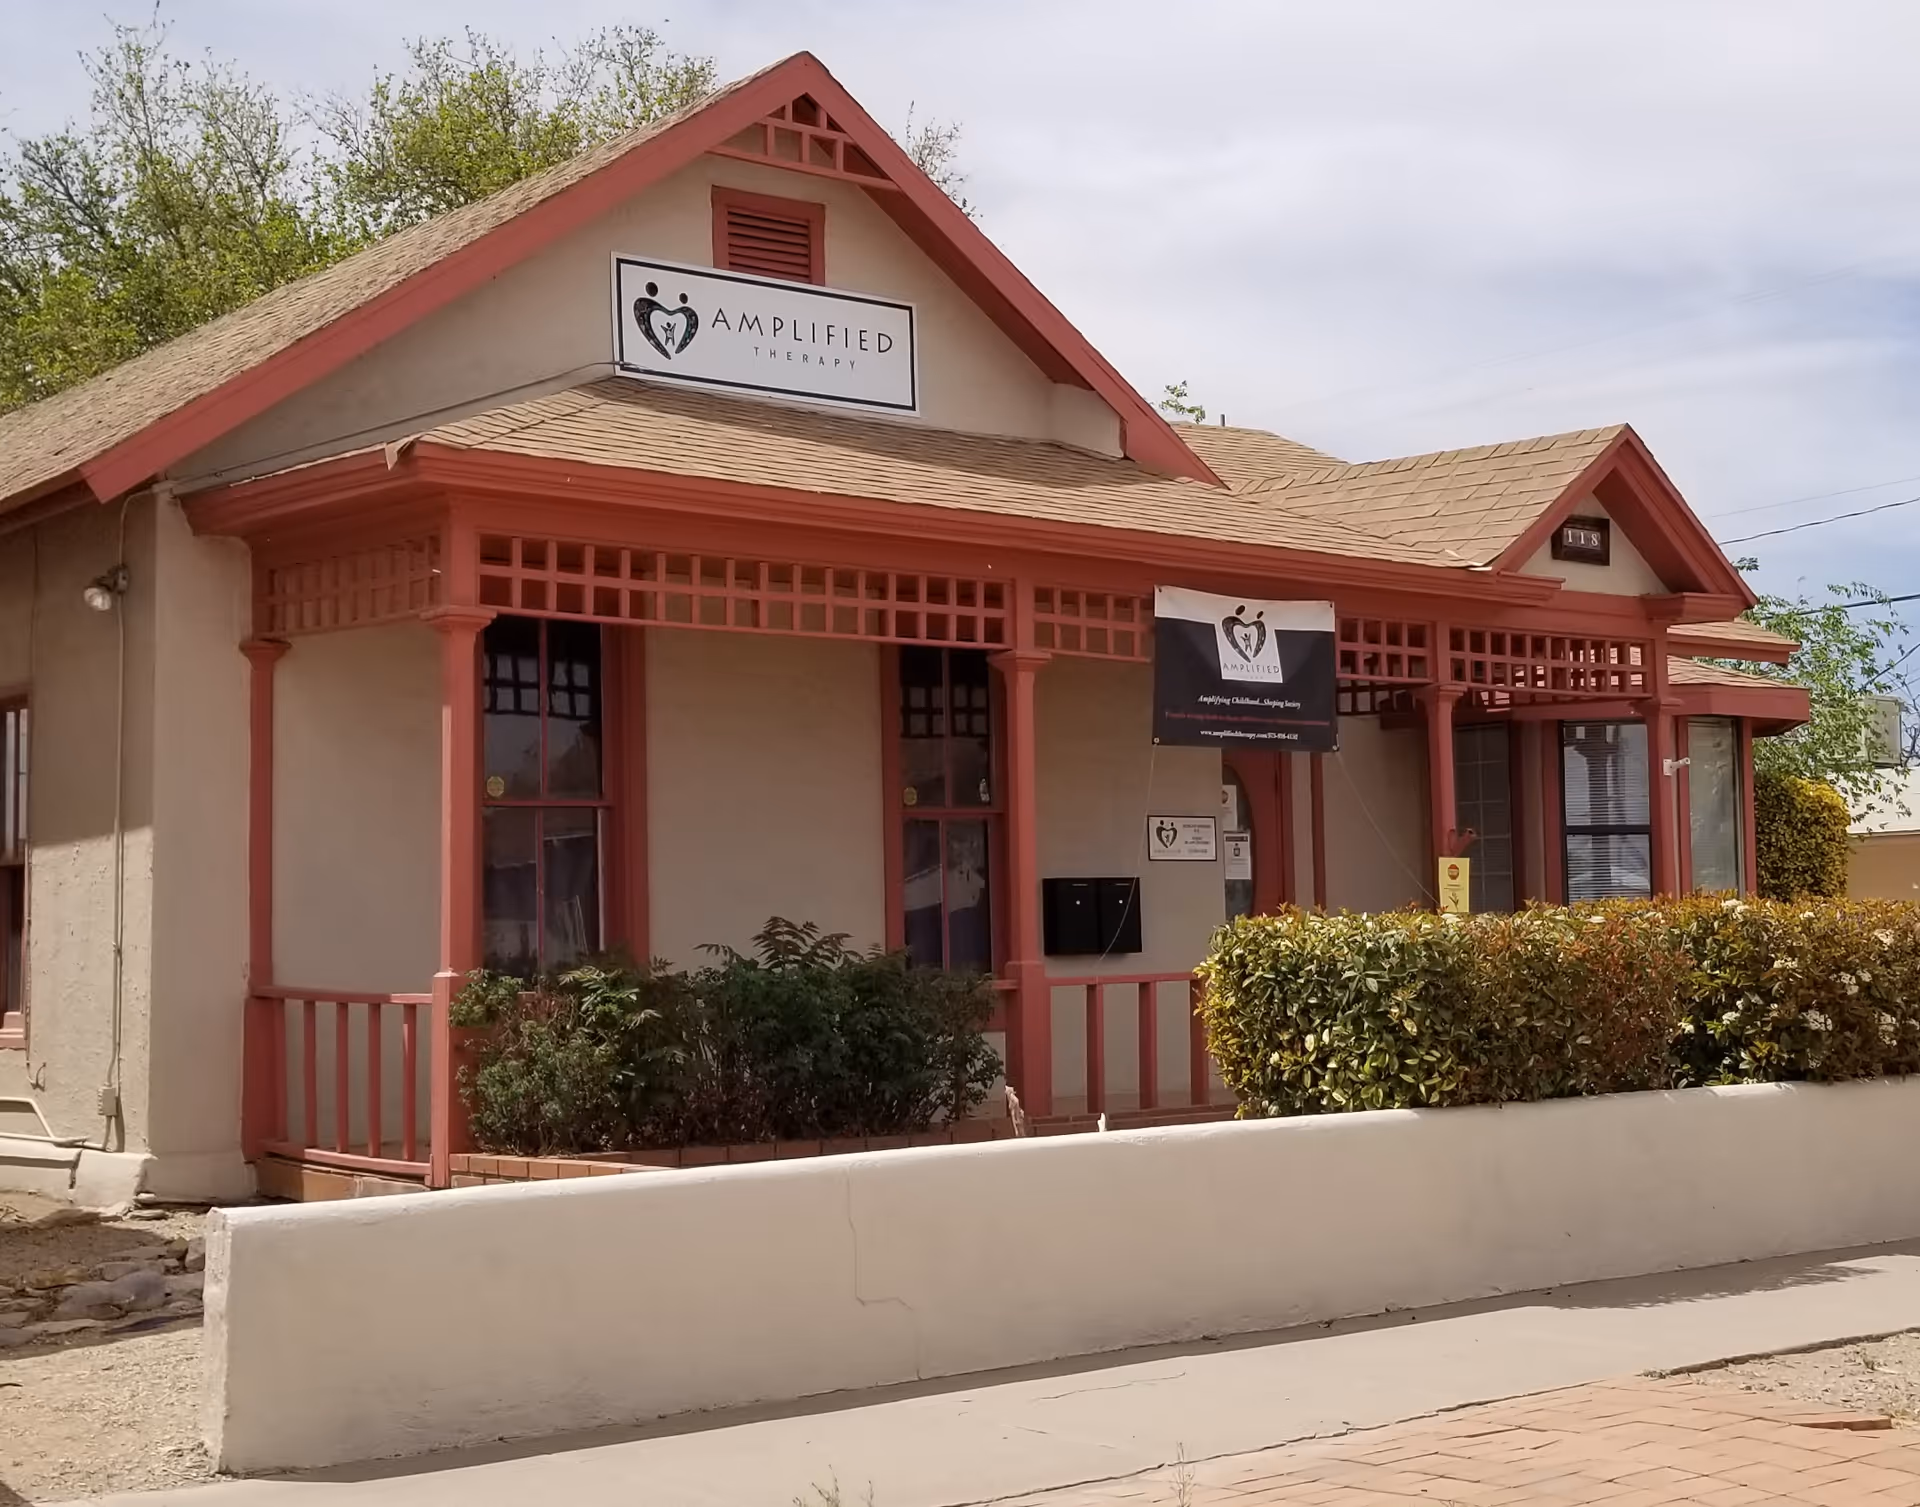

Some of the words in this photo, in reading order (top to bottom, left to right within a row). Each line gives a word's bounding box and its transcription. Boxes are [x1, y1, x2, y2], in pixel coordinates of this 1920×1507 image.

[711, 307, 894, 354] AMPLIFIED
[753, 346, 857, 371] THERAPY
[1567, 529, 1599, 547] 118
[1222, 662, 1280, 674] AMPLIFIED
